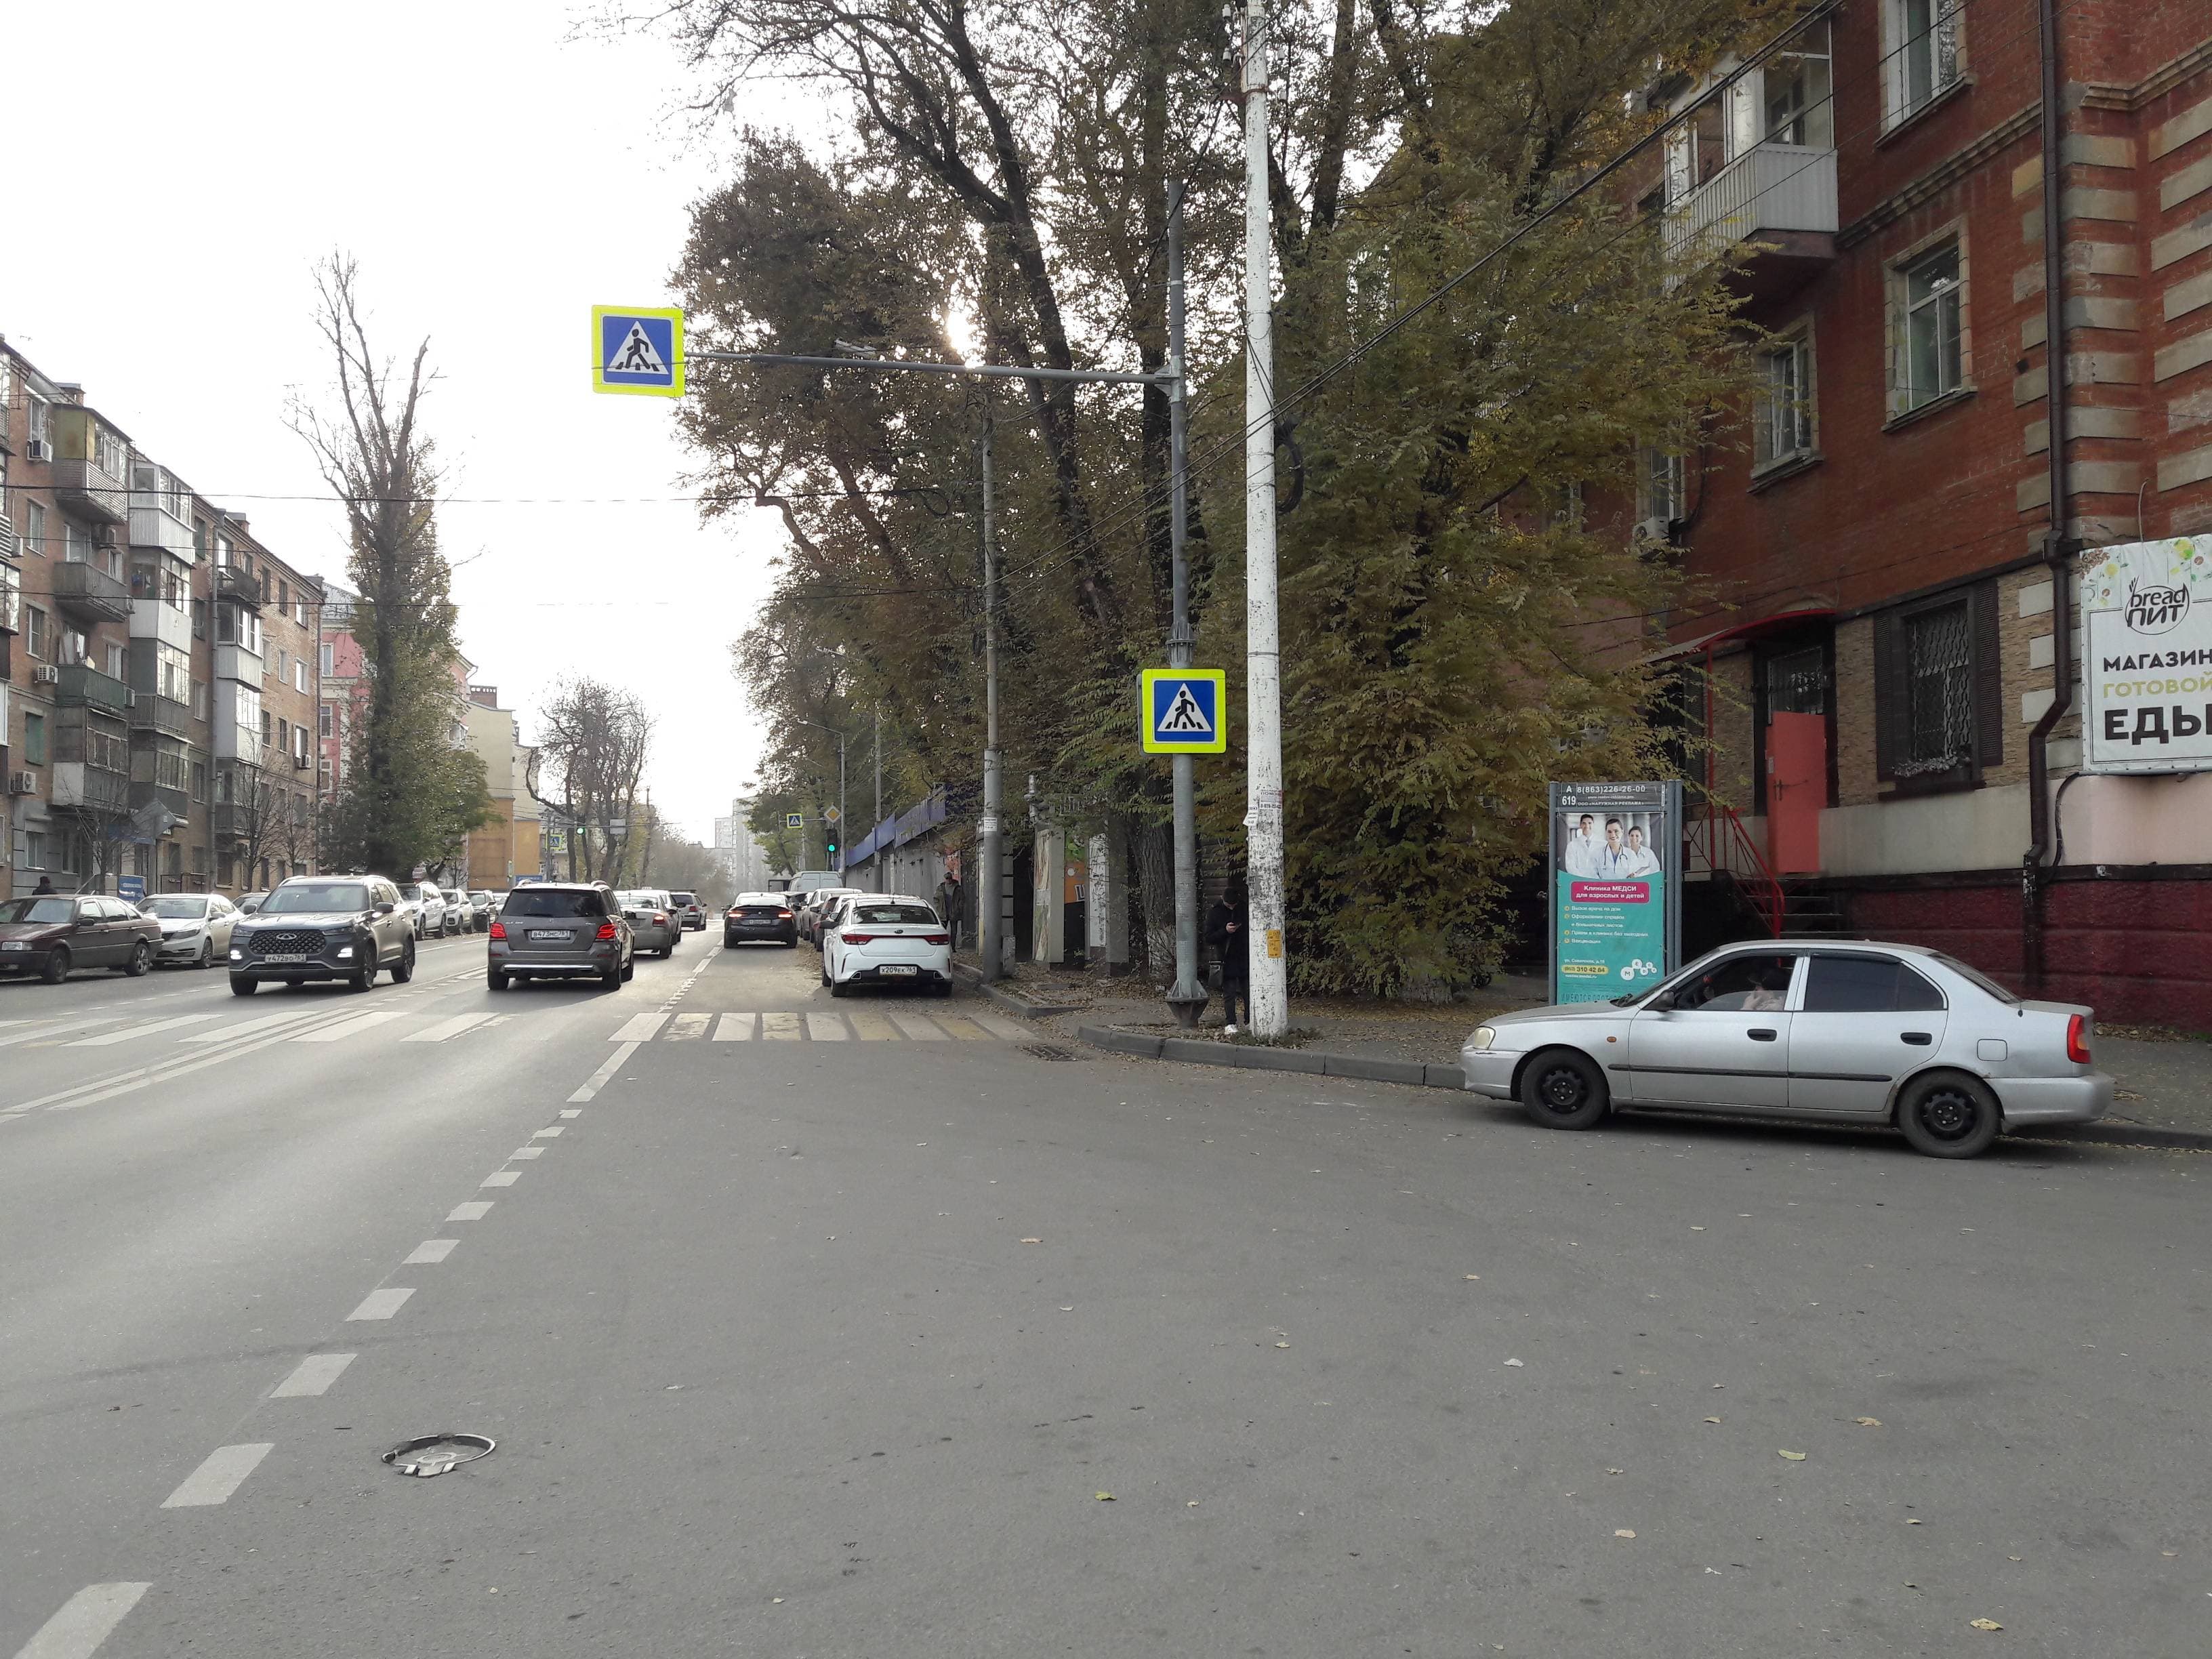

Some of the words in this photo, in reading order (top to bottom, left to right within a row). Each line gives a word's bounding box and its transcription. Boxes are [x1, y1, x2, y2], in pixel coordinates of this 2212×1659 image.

[2130, 580, 2186, 608] bread
[2127, 604, 2185, 628] ПИТ
[2103, 649, 2212, 672] МАГАЗИН
[2103, 671, 2212, 699] ГОТОВОЙ
[1561, 796, 1576, 806] 619
[1577, 785, 1645, 795] 8(863)226-26-00
